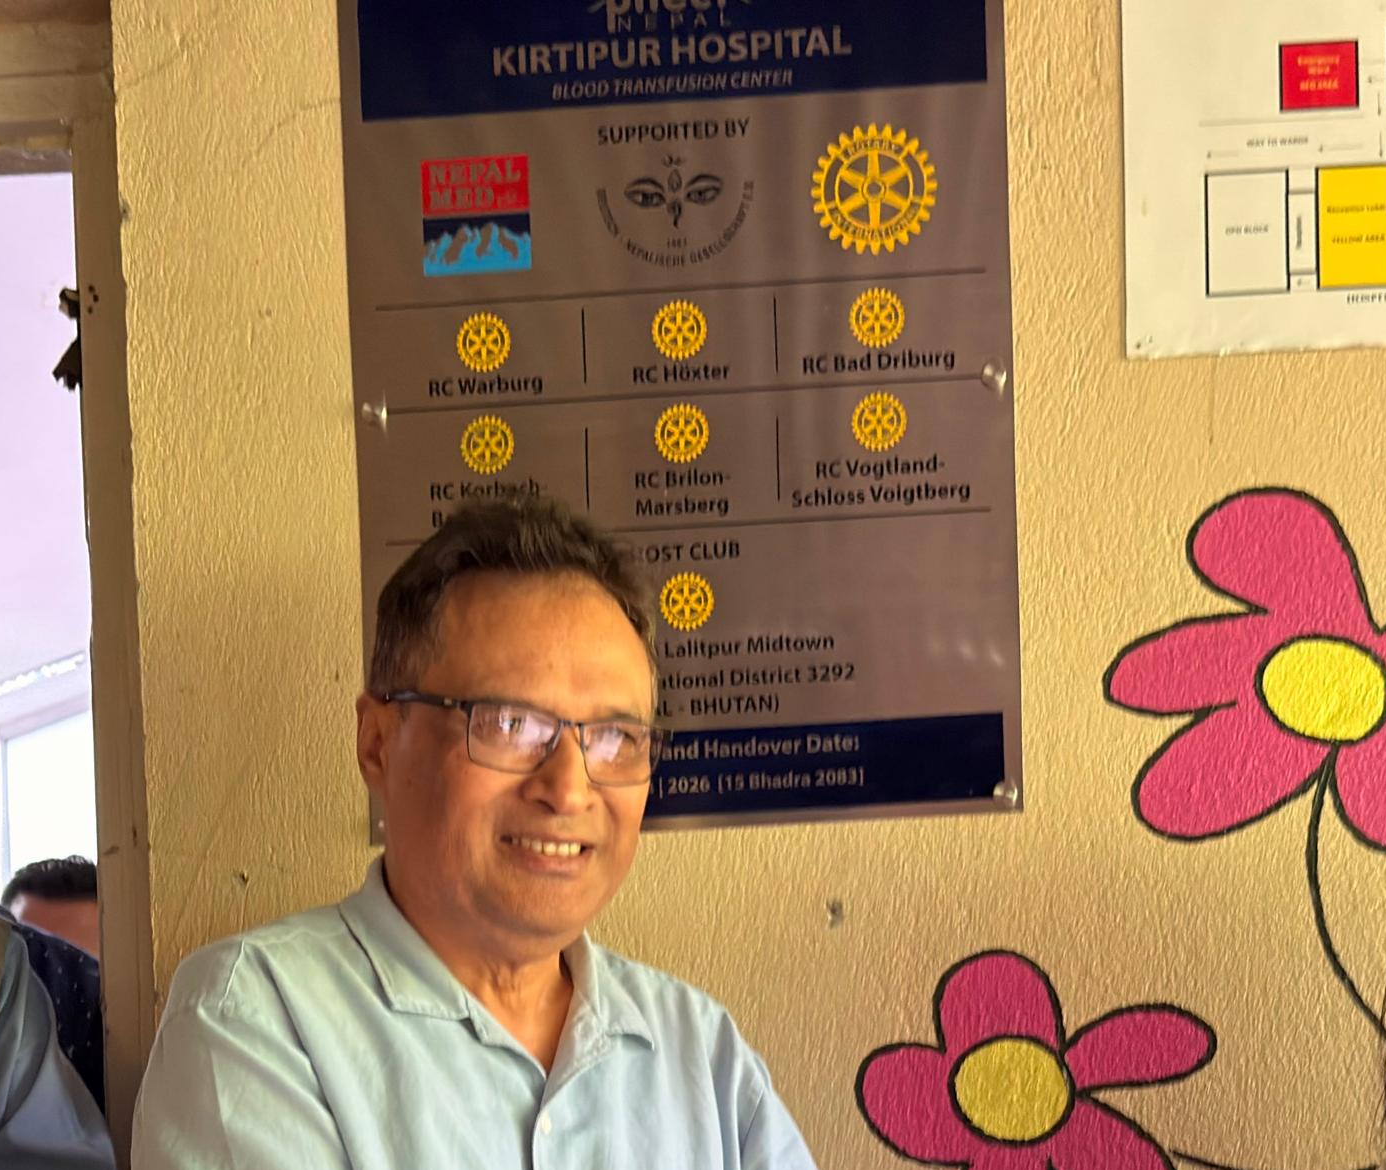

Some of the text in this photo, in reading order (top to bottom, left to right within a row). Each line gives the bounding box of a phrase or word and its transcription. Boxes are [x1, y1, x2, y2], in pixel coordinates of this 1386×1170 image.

[492, 26, 853, 76] KIRTIPUR HOSPITAL
[552, 68, 794, 101] BLOOD TRANSFUSION CENTER
[596, 117, 751, 145] SUPPORTED BY
[430, 160, 521, 184] NEPAL
[632, 362, 730, 384] RC Höxter
[802, 349, 955, 375] RC Bad Driburg
[428, 375, 544, 397] RC Warburg
[635, 468, 731, 489] RC Brilon-
[815, 453, 945, 480] RC Vogtland-
[430, 482, 454, 501] RC
[791, 481, 971, 508] Schloss Voigtberg
[635, 495, 730, 518] Marsberg
[690, 540, 741, 561] CLUB
[664, 634, 835, 660] Lalitpur Midtown
[730, 667, 801, 688] District
[807, 663, 856, 683] 3292
[690, 694, 781, 717] BHUTAN)
[703, 735, 802, 760] Handover
[806, 733, 860, 755] Date:
[667, 776, 711, 795] 2026
[749, 769, 811, 789] Bhadra
